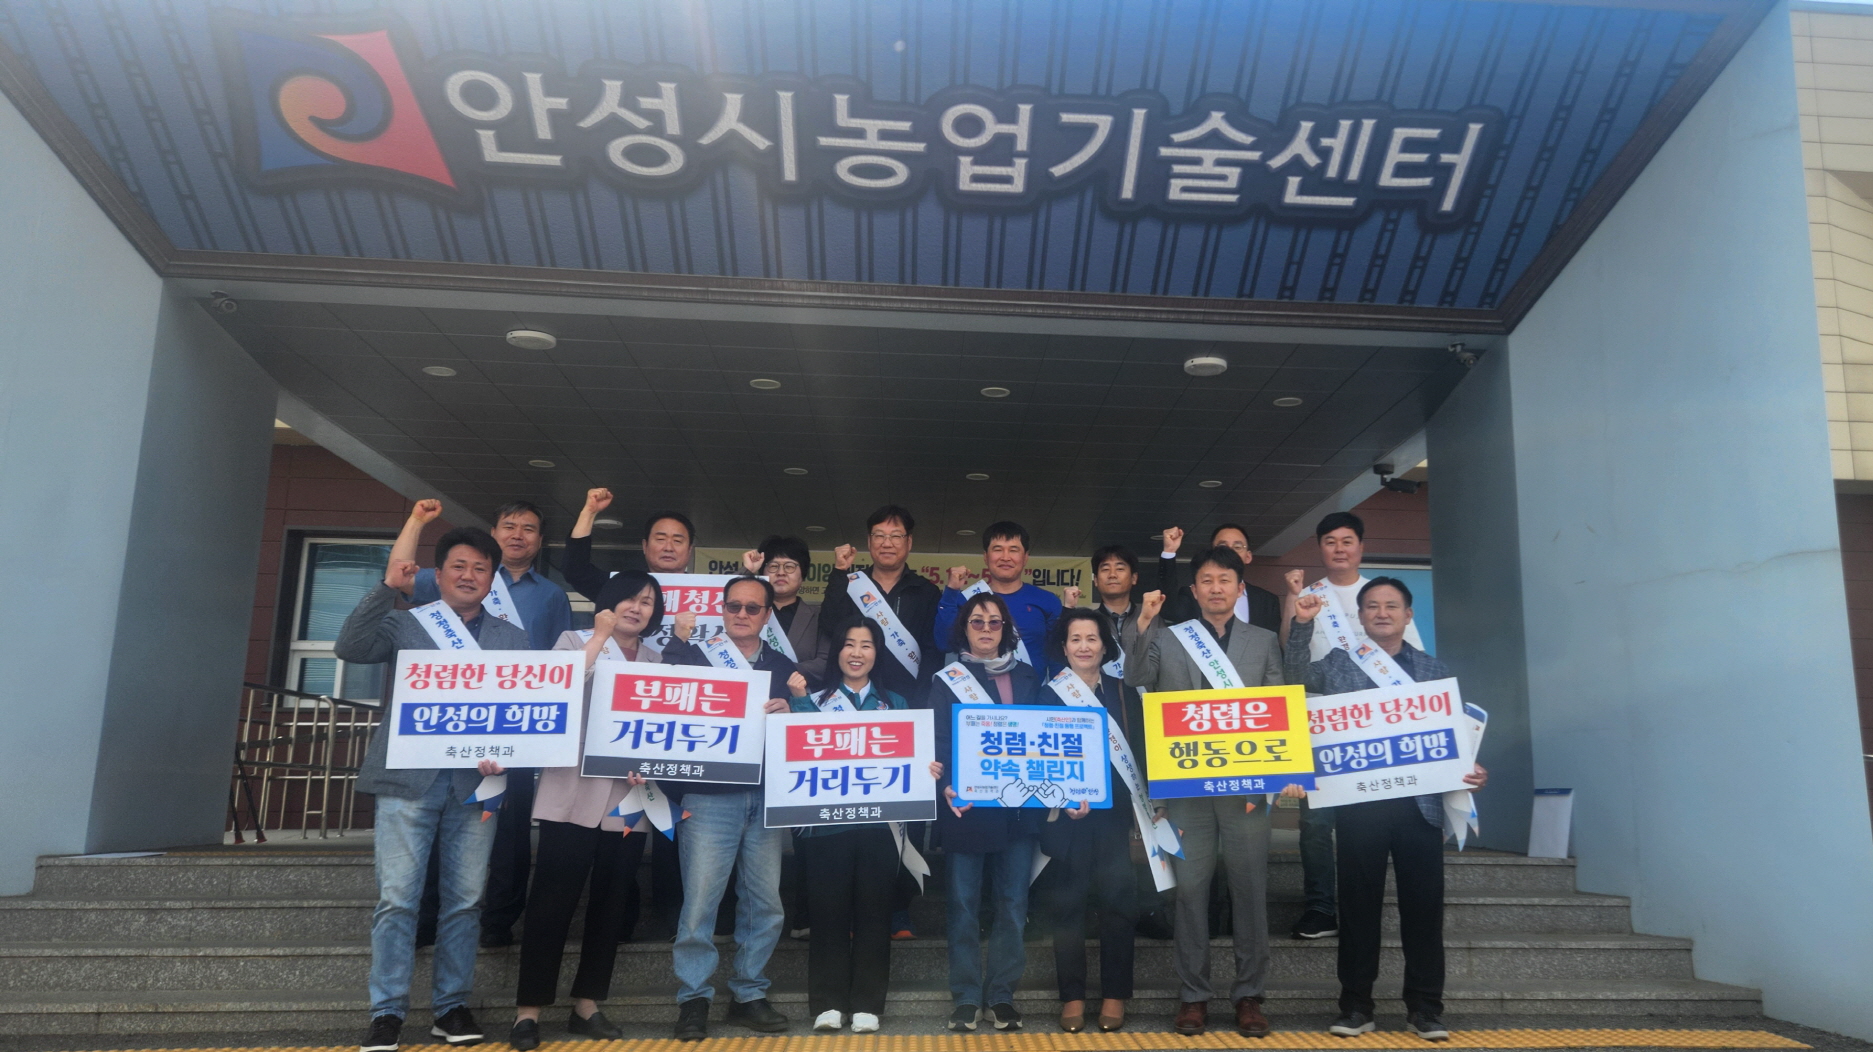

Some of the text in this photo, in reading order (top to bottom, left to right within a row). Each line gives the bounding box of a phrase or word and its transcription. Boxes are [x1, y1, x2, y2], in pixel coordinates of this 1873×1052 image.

[443, 68, 1488, 214] 안성시농업기술센터
[1183, 625, 1234, 688] 청정축산 안성시
[403, 662, 574, 690] 청렴한 당신이
[630, 679, 731, 714] 부패는
[1378, 691, 1452, 725] 당신이
[412, 704, 560, 733] 안성의 희망
[1181, 701, 1272, 732] 청렴은
[445, 745, 515, 759] 축산정책과
[609, 719, 741, 755] 거리두기
[802, 726, 899, 758] 부패는
[1318, 731, 1450, 773] 안성의 희망
[639, 761, 705, 777] 축산정책과
[1168, 738, 1293, 770] 행동으로
[788, 763, 911, 798] 거리두기
[980, 759, 1085, 782] 약속 챌린지
[1203, 777, 1266, 793] 축산정책과
[1355, 774, 1419, 793] 축산정책과
[818, 805, 883, 821] 축산정책과
